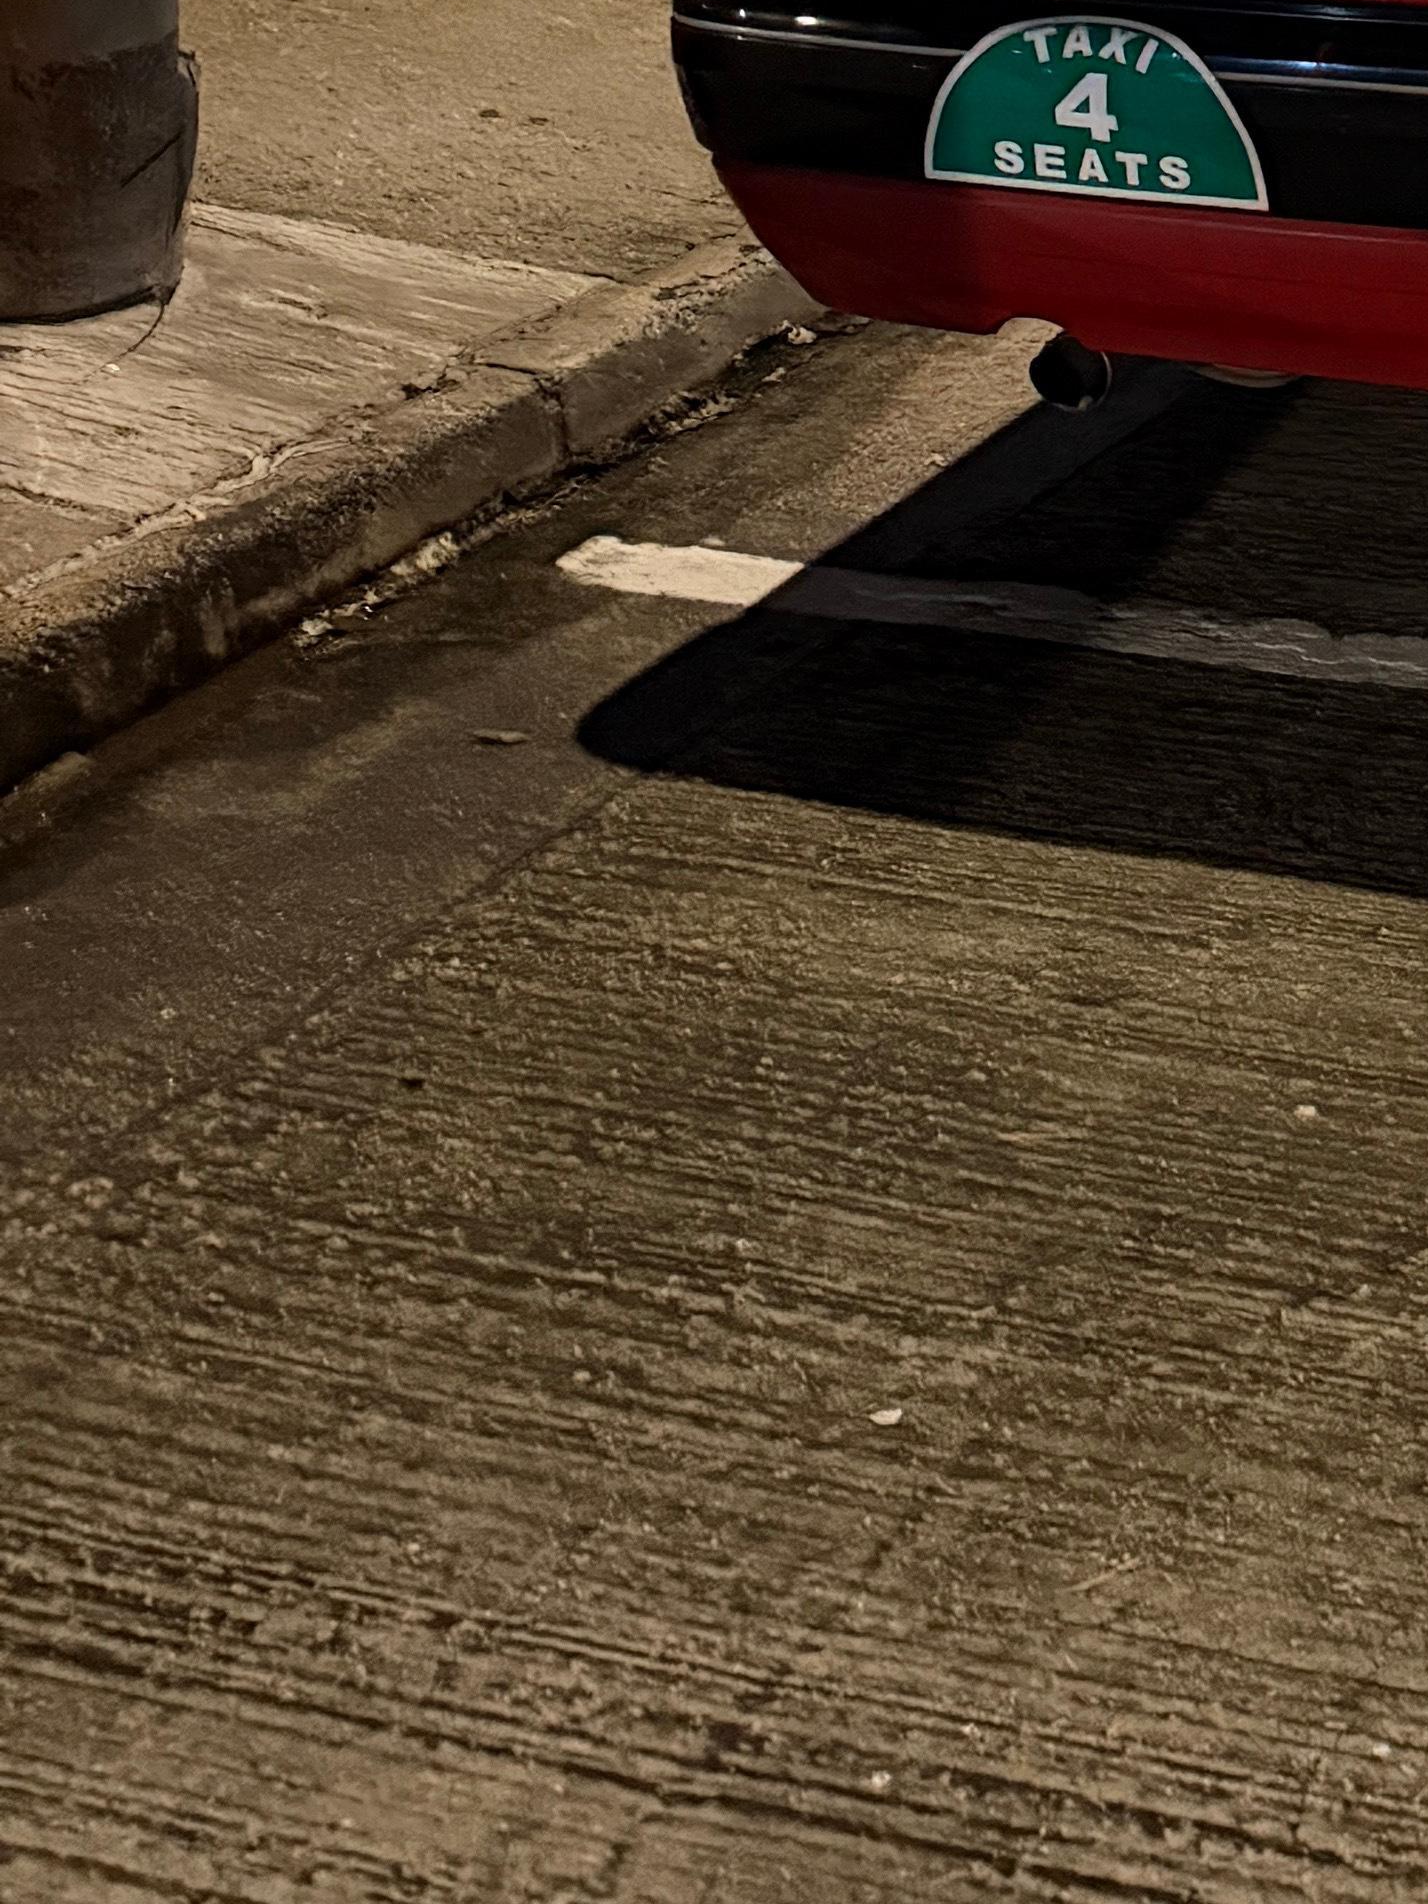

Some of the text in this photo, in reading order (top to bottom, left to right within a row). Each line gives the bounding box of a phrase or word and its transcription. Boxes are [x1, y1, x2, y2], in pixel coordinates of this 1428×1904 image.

[1023, 25, 1159, 74] TAXI
[1055, 72, 1119, 142] 4
[993, 140, 1192, 191] SEATS
